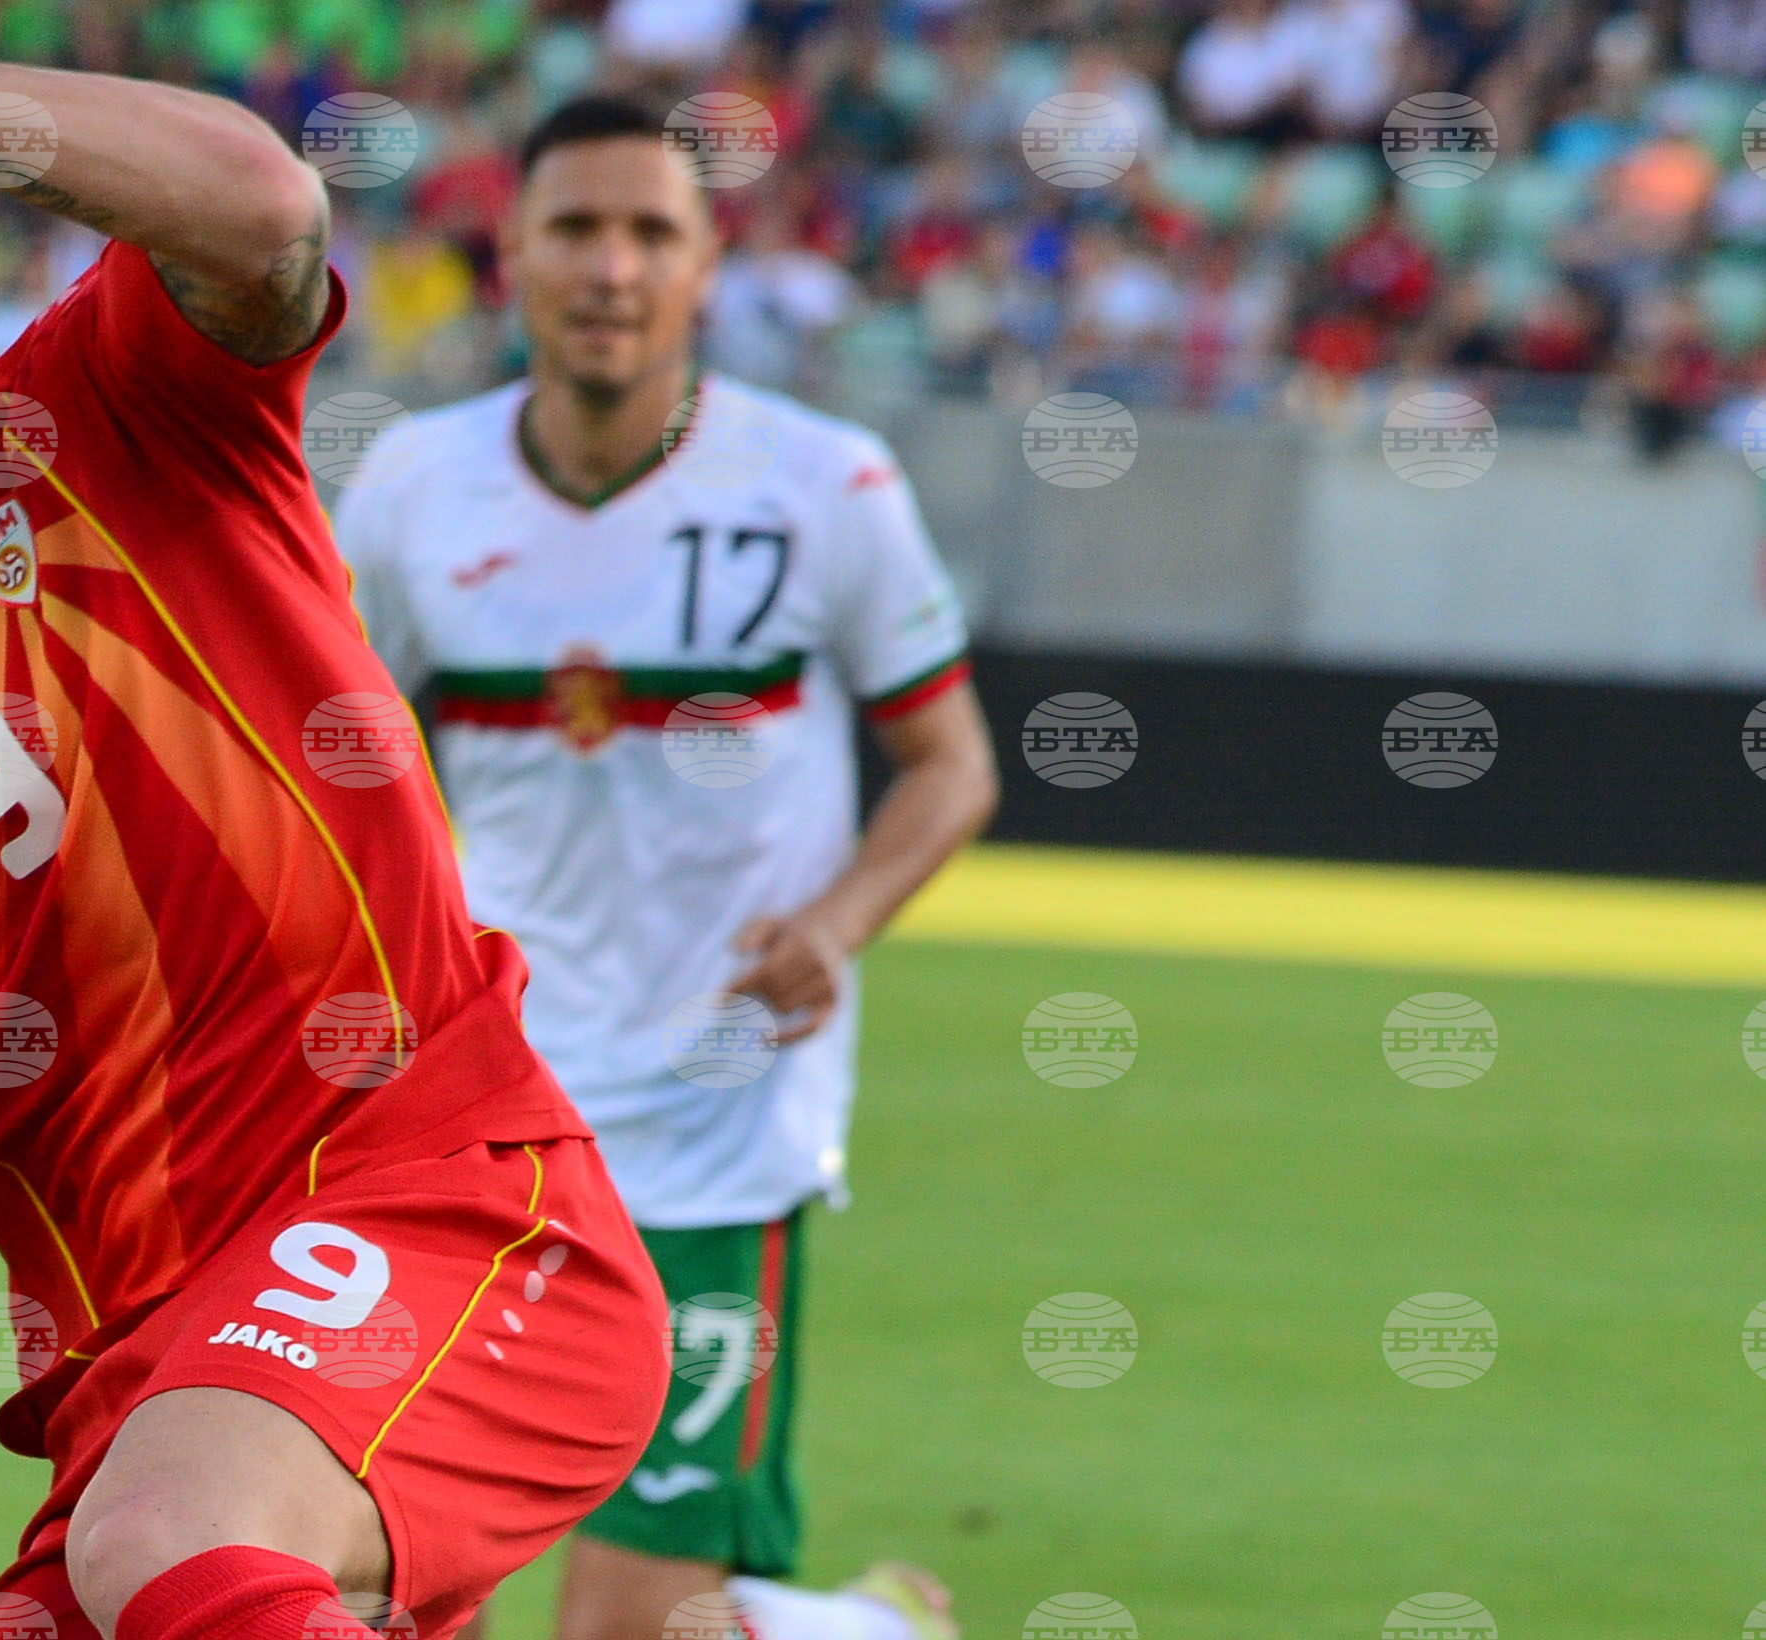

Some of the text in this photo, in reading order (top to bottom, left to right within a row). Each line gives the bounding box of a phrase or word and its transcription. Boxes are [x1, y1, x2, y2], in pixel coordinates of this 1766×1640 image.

[664, 525, 790, 648] 17
[253, 1222, 391, 1329] 9
[207, 1322, 318, 1370] JAKO
